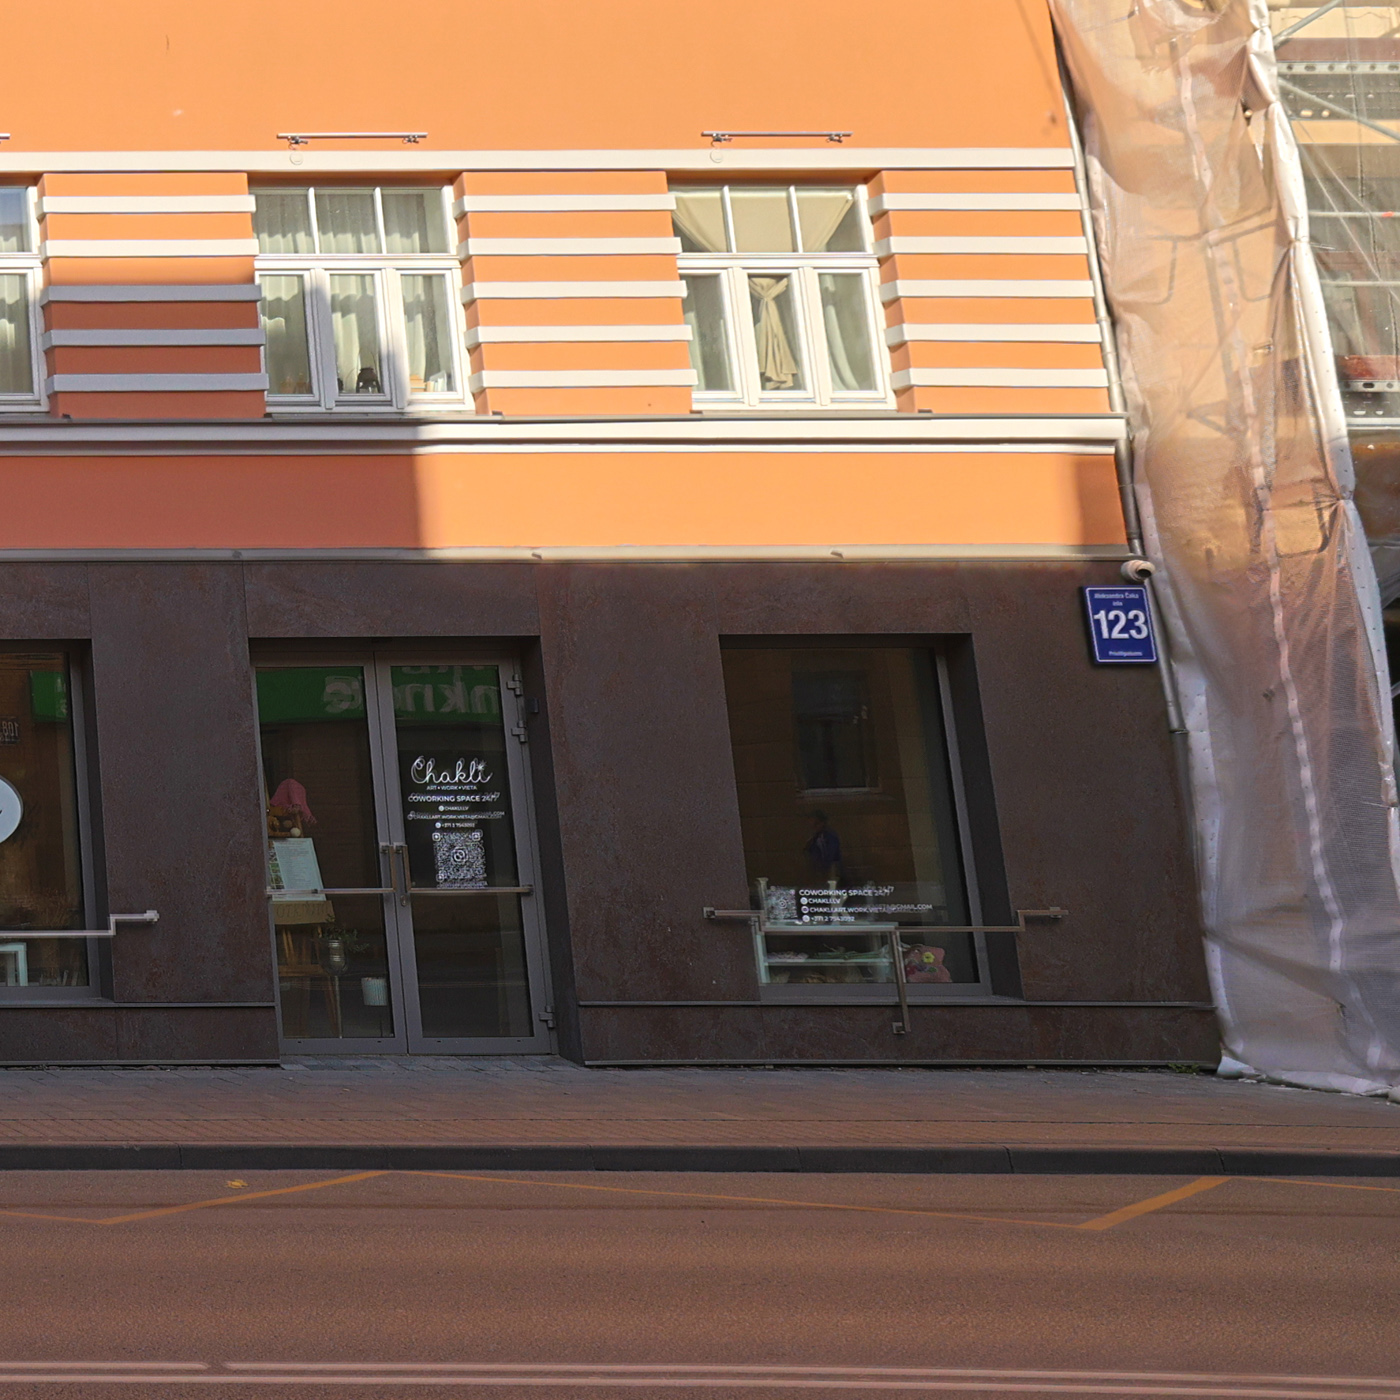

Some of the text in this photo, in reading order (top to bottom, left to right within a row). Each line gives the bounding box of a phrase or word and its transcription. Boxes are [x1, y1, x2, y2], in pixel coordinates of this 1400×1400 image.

[1094, 610, 1148, 639] 123
[411, 756, 493, 784] Chakli
[408, 793, 455, 802] COWORKING
